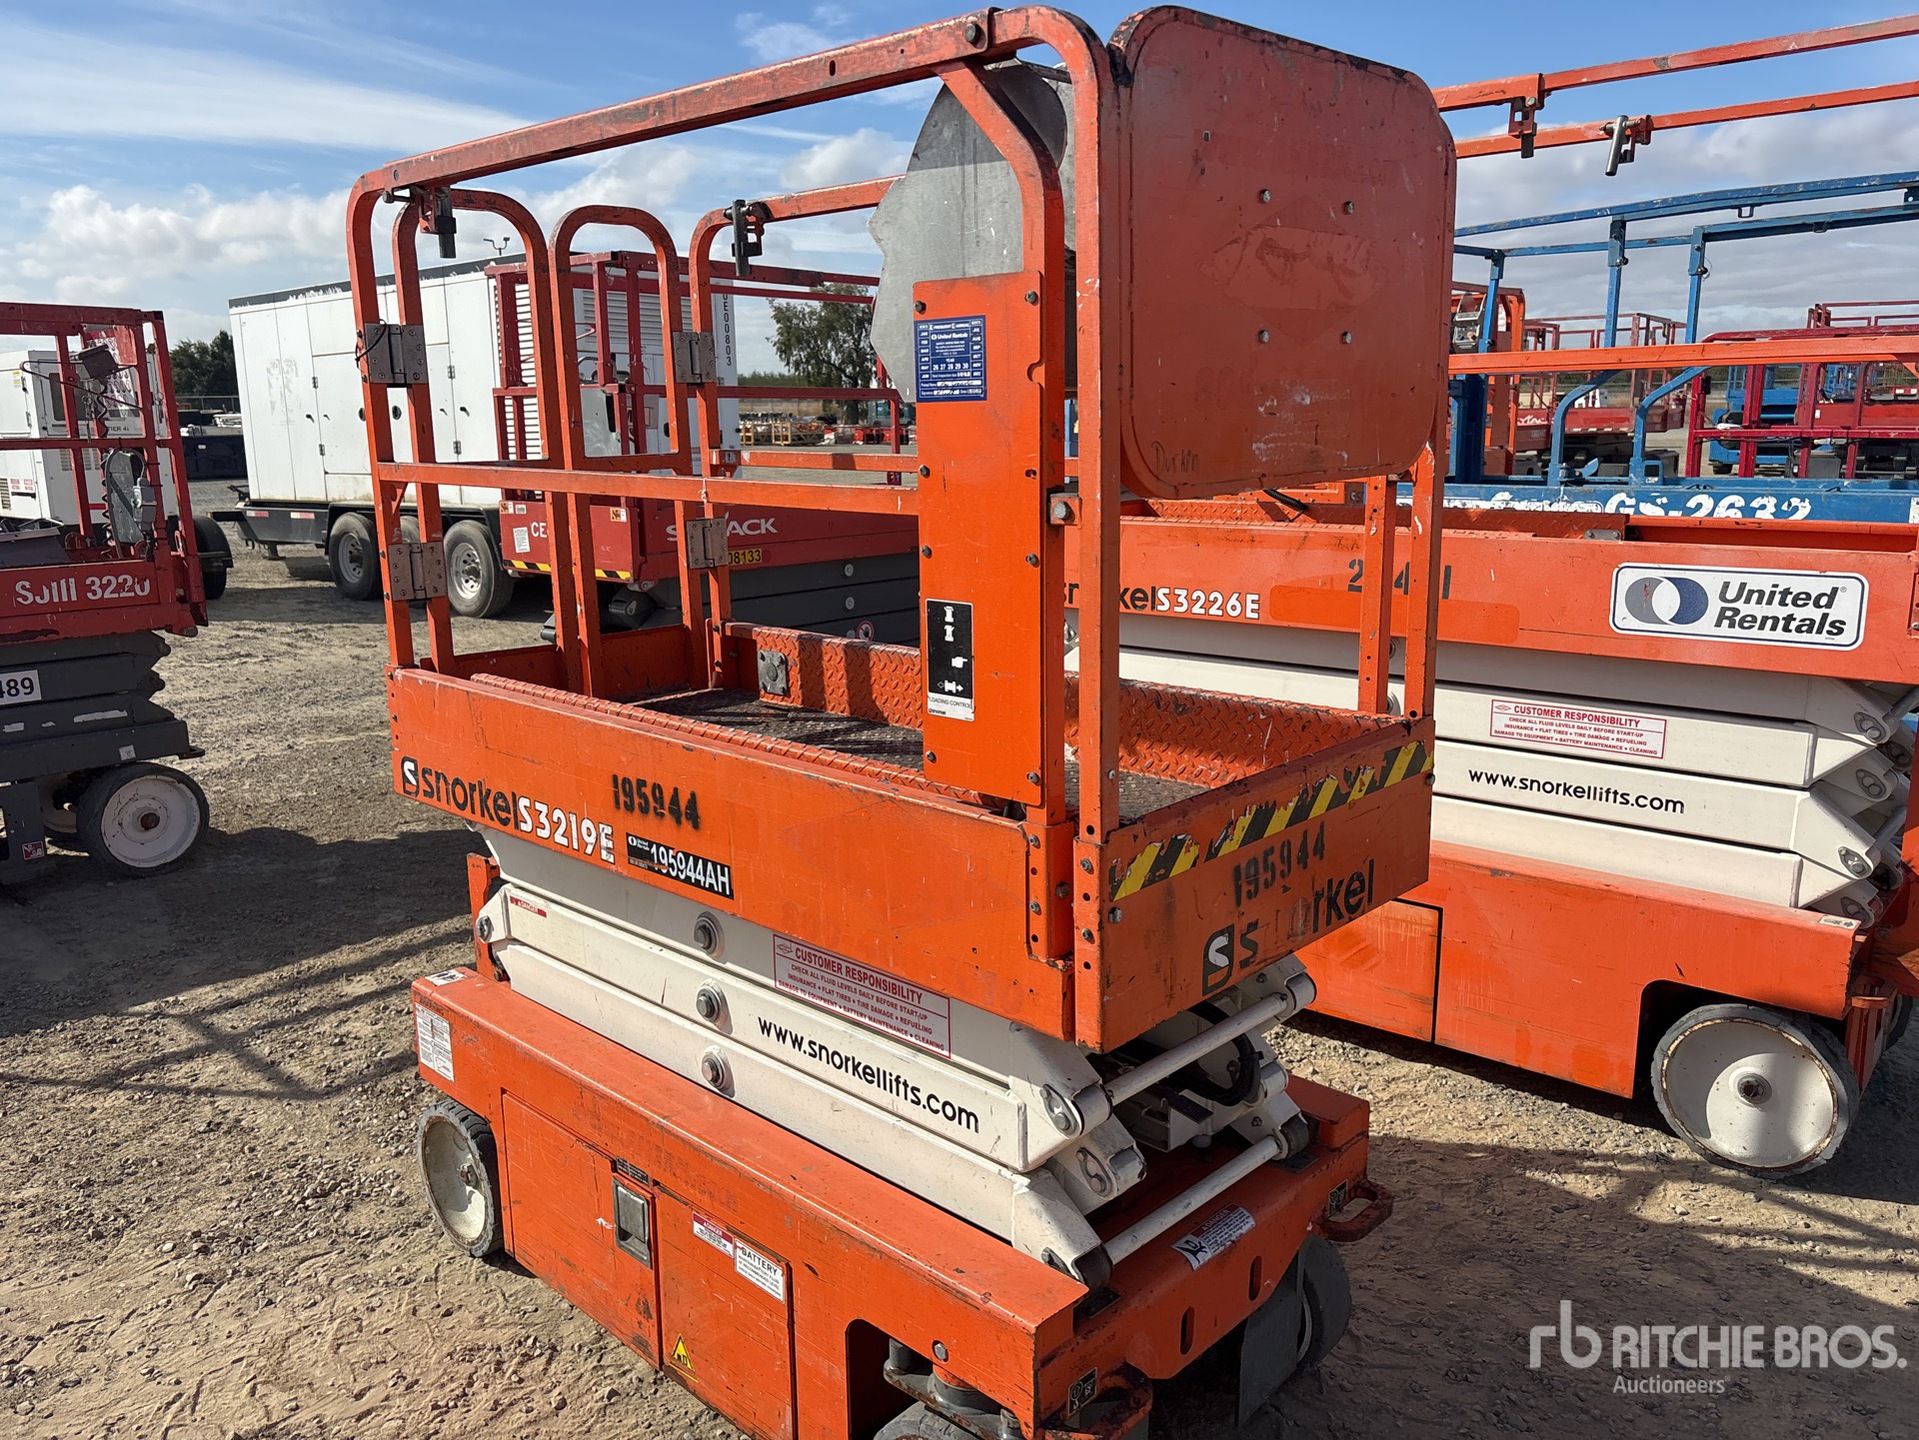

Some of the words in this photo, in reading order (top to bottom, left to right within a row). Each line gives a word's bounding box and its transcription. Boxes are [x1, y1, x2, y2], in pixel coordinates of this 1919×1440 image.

[85, 574, 150, 601] 3220
[1156, 587, 1260, 619] S3226E
[1714, 606, 1846, 636] Rentals
[1504, 724, 1534, 732] INSURANCE
[1588, 733, 1610, 741] DAMAGE
[1616, 737, 1647, 746] REFUELING
[1514, 705, 1562, 719] CUSTOMER
[1564, 712, 1640, 728] RESPONSIBILITY
[1616, 730, 1644, 738] START-UP
[1524, 733, 1553, 741] EQUIPMENT
[1559, 737, 1583, 745] BATTERY
[1584, 740, 1623, 750] MAINTENANCE
[1629, 746, 1658, 755] CLEANING
[611, 774, 701, 830] 195944
[1468, 769, 1685, 814] www.snorkellifts.com
[650, 843, 730, 895] 195944AH
[1233, 821, 1325, 908] 195944
[791, 964, 809, 977] CHECK
[810, 970, 819, 980] ALL
[821, 975, 836, 987] FLUID
[837, 980, 857, 995] LEVELS
[859, 989, 874, 1000] DAILY
[876, 996, 898, 1010] BEFORE
[900, 1005, 928, 1021] START-UP
[795, 947, 843, 975] CUSTOMER
[845, 965, 922, 1004] RESPONSIBILITY
[788, 973, 816, 990] INSURANCE
[822, 986, 835, 997] FLAT
[837, 992, 851, 1003] TIRES
[857, 1000, 870, 1011] TIRE
[871, 1005, 894, 1020] DAMAGE
[900, 1016, 932, 1035] REFUELING
[757, 1016, 980, 1134] www.snorkellifts.com
[741, 1246, 778, 1275] BATTERY
